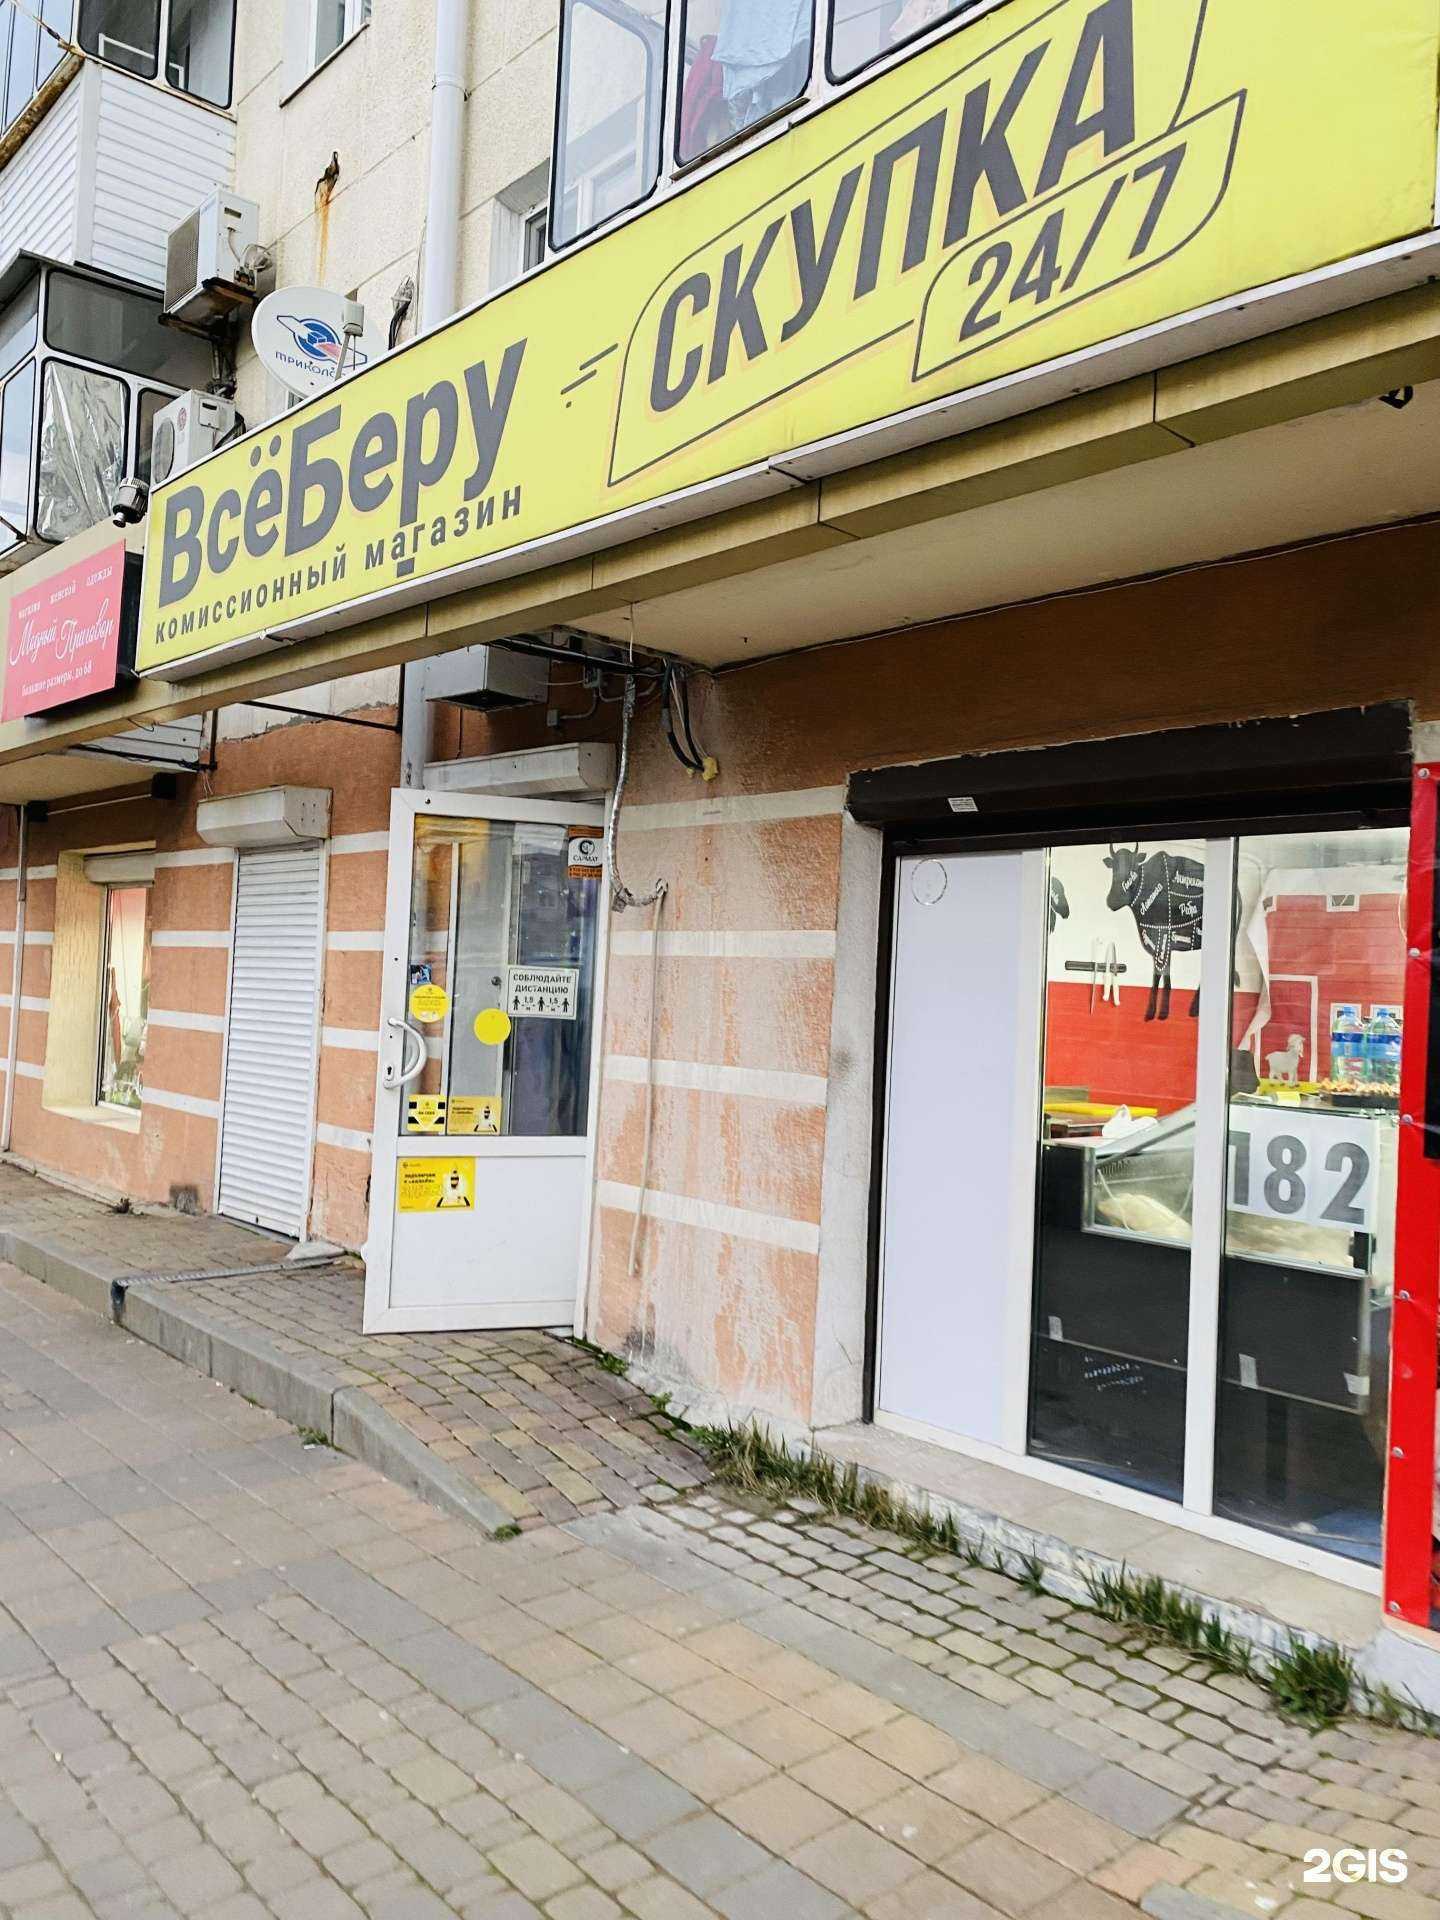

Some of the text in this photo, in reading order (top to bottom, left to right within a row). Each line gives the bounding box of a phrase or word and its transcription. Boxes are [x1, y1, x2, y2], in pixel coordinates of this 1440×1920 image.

[651, 0, 1135, 412] СКУПКА
[959, 142, 1187, 341] 24/7
[159, 337, 528, 608] ВсёБеру
[155, 485, 521, 644] комиссионный магазин
[513, 973, 571, 984] СОБЛЮДАЙТЕ
[515, 985, 569, 995] ДИСТАНЦИЮ
[1229, 1130, 1370, 1225] 182
